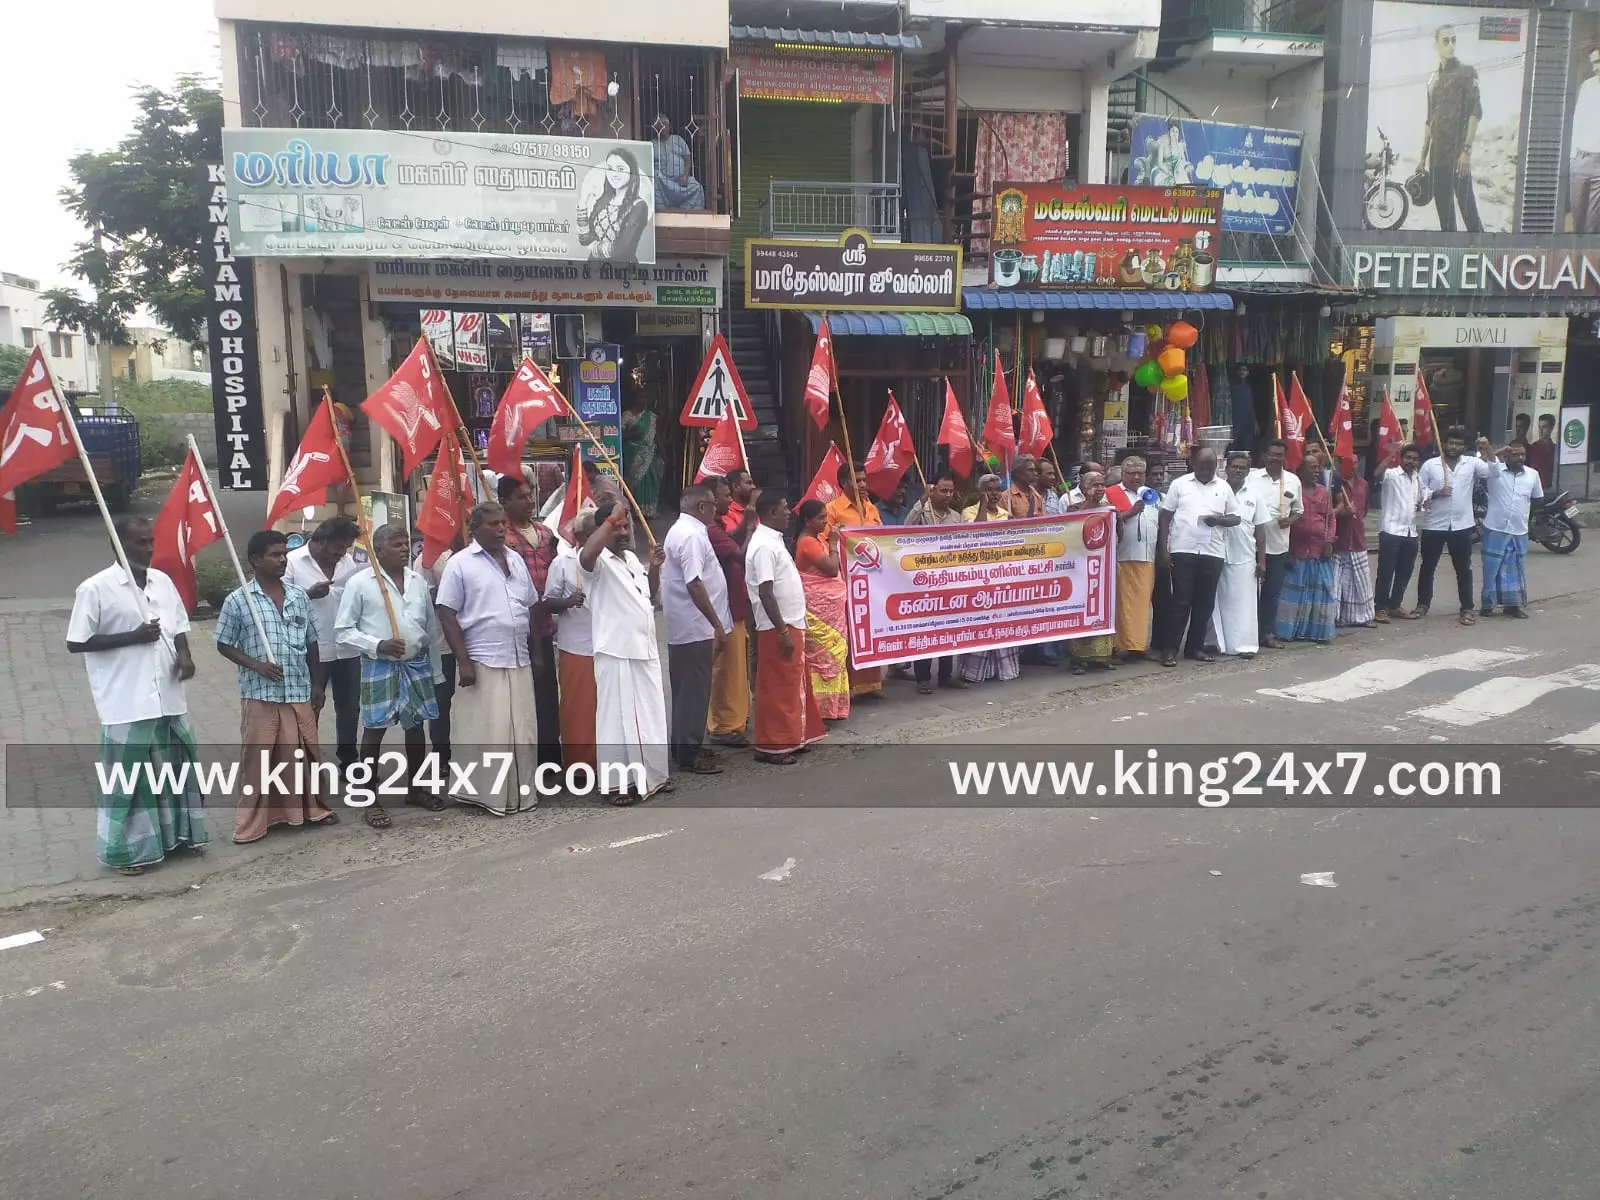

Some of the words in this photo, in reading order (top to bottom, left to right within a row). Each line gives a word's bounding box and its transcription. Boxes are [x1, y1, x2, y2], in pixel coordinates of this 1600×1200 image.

[234, 139, 390, 188] மரியா
[398, 162, 467, 186] மகளிர்
[474, 166, 577, 191] தையலகம்
[512, 140, 549, 158] 97517
[553, 143, 591, 159] 98150
[1033, 194, 1127, 222] மகேஸ்வரி
[1131, 200, 1179, 223] மெட்டல்
[1182, 202, 1217, 224] மார்ட்
[207, 164, 242, 301] KAMALAM
[375, 259, 431, 276] மரியா
[435, 258, 492, 277] மகளிர்
[496, 261, 579, 281] தையலகம்
[582, 263, 592, 280] &
[652, 262, 709, 282] பார்லர்
[842, 244, 867, 266] ஸ்ரீ
[1354, 251, 1450, 290] PETER
[1461, 252, 1600, 290] ENGLAN
[755, 263, 865, 297] மாதேஸ்வரா
[1455, 327, 1506, 344] DIWALI
[220, 337, 252, 488] HOSPITAL
[1028, 560, 1053, 574] கட்சி
[898, 594, 968, 615] கண்டன
[971, 580, 1061, 609] ஆர்ப்பாட்டம்
[1088, 559, 1100, 613] CPI
[852, 580, 868, 648] CPI
